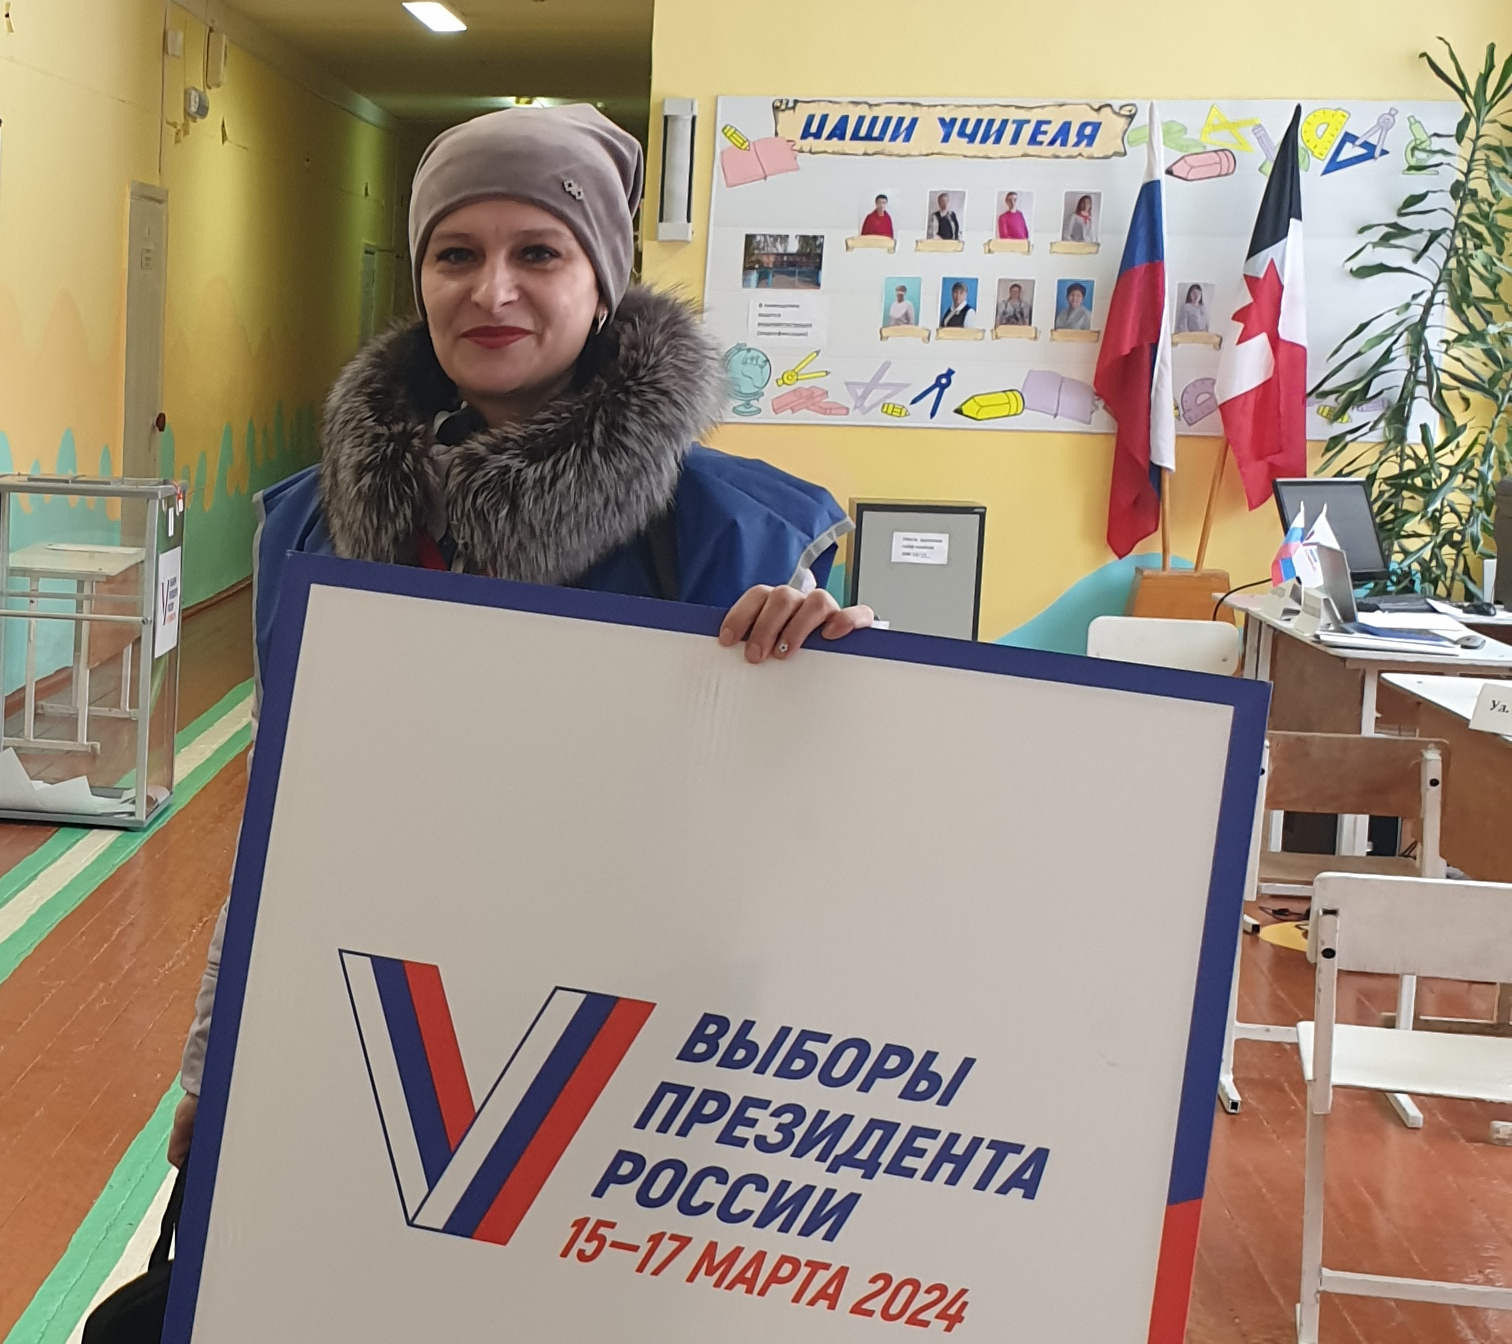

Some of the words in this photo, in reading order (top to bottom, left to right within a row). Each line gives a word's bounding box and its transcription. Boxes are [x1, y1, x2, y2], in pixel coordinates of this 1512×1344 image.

[800, 113, 919, 143] НАШИ
[937, 116, 1103, 148] УЧИТЕЛЯ
[675, 1011, 978, 1107] ВЫБОРЫ
[633, 1080, 1051, 1201] ПРЕЗИДЕНТА
[591, 1148, 863, 1243] РОССИИ
[685, 1240, 851, 1311] МАРТА
[849, 1271, 970, 1333] 2024
